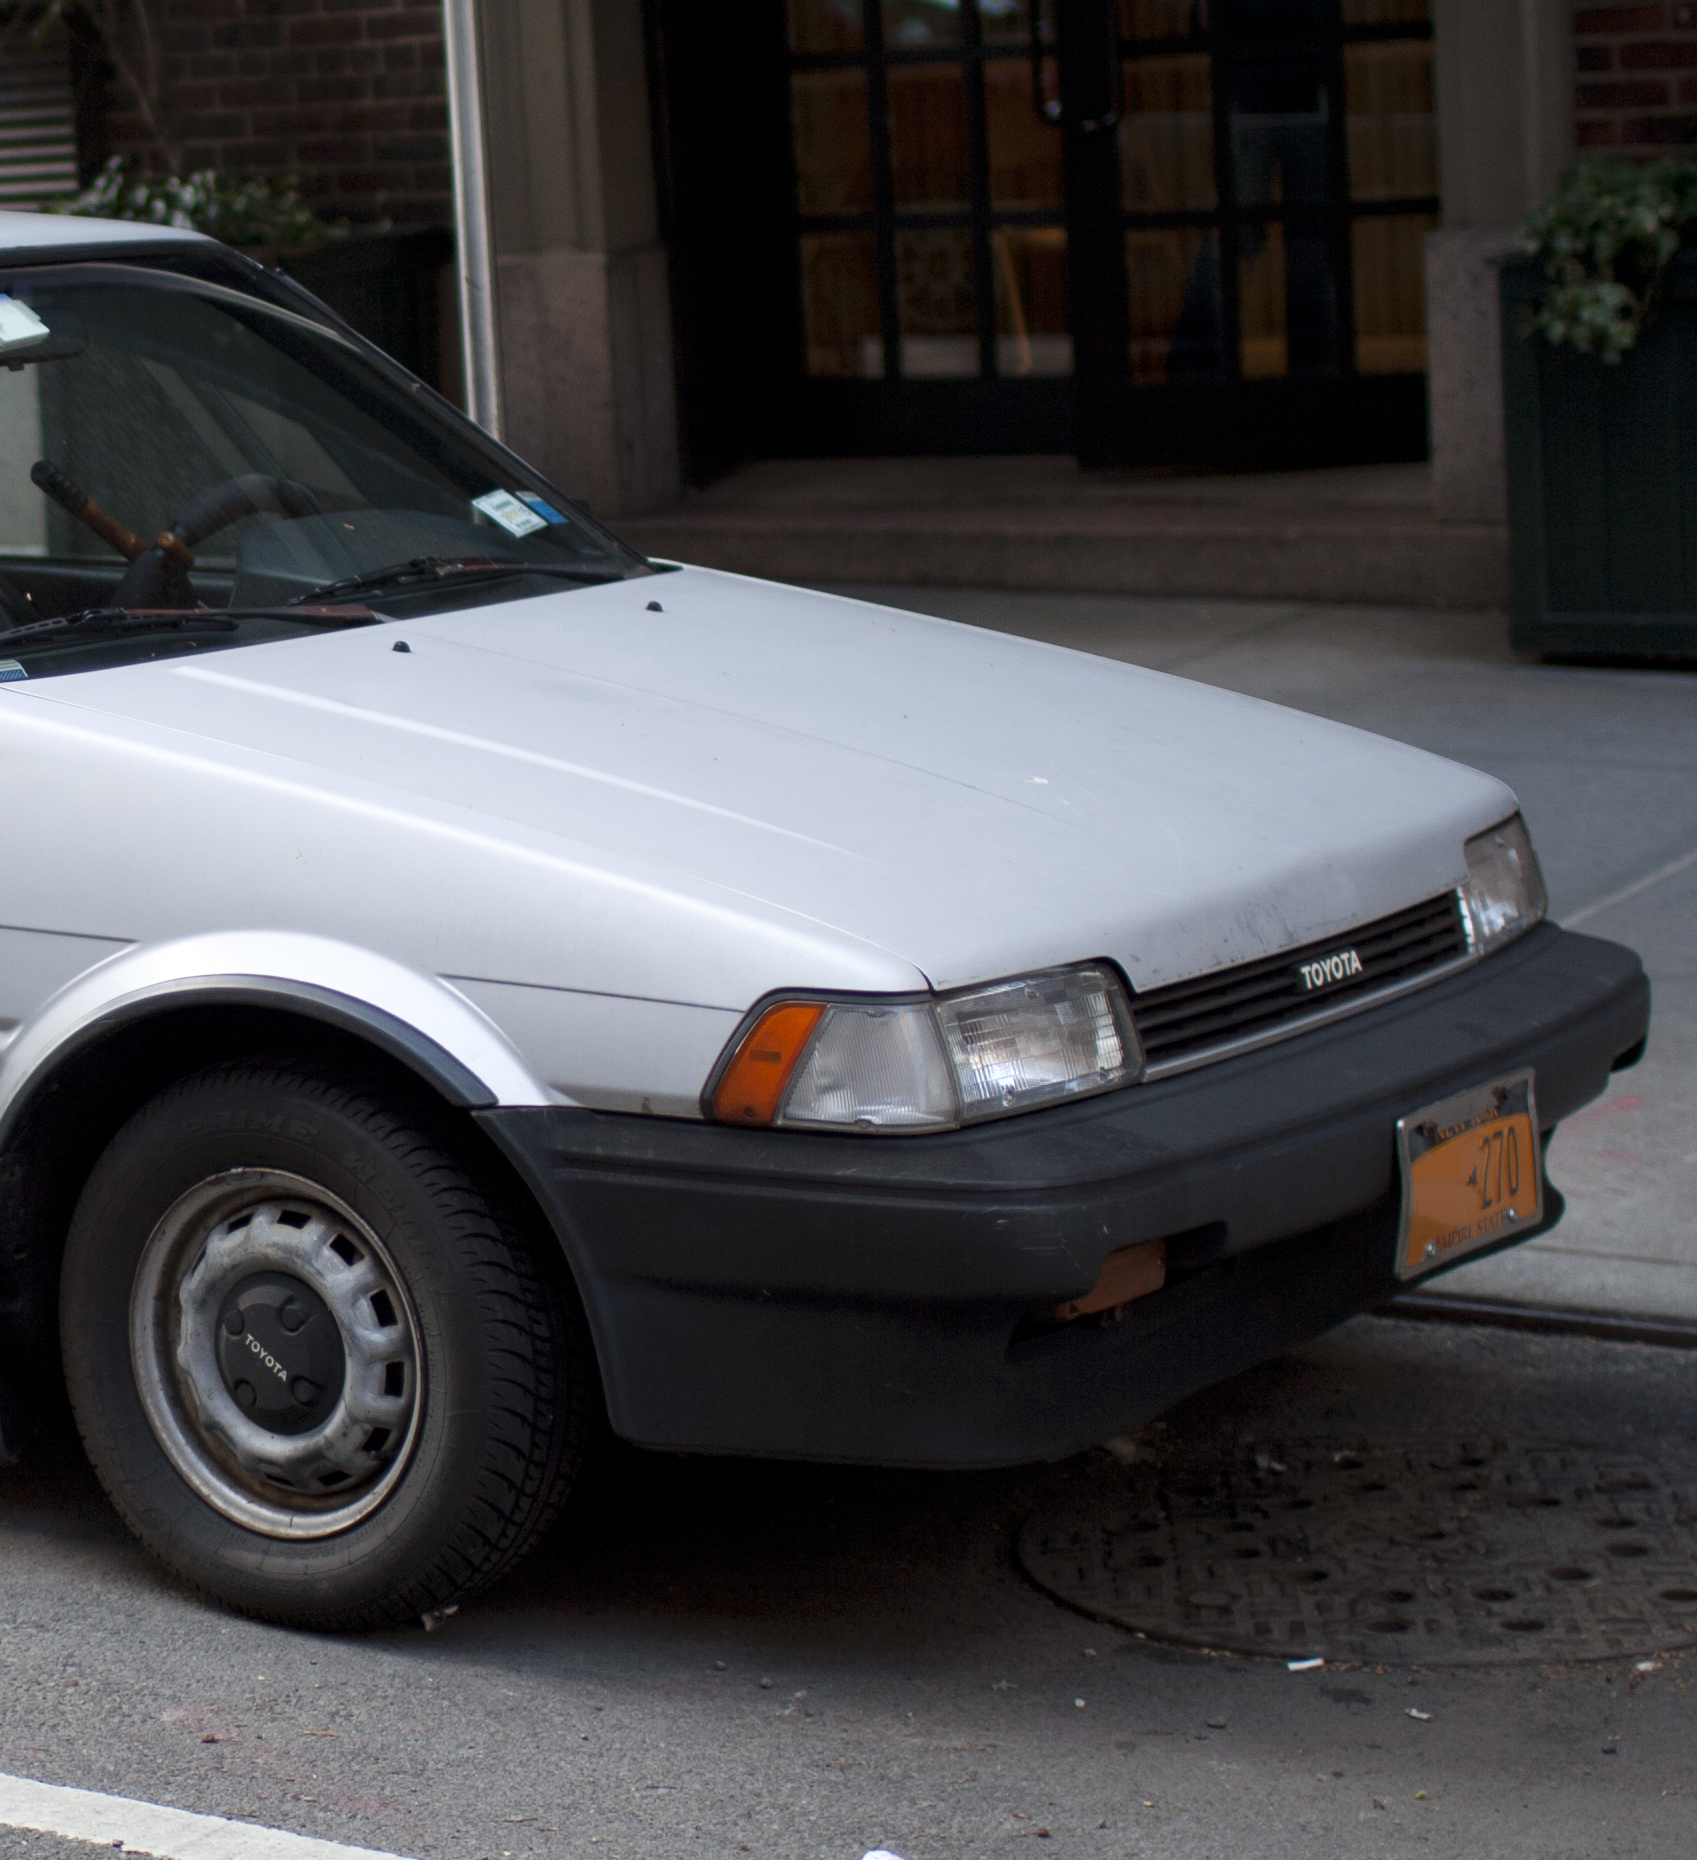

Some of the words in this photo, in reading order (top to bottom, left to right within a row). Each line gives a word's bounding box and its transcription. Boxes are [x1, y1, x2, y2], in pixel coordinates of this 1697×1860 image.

[1301, 950, 1363, 990] TOYOTA
[1480, 1124, 1520, 1209] 270
[245, 1333, 288, 1381] TOYOTA
